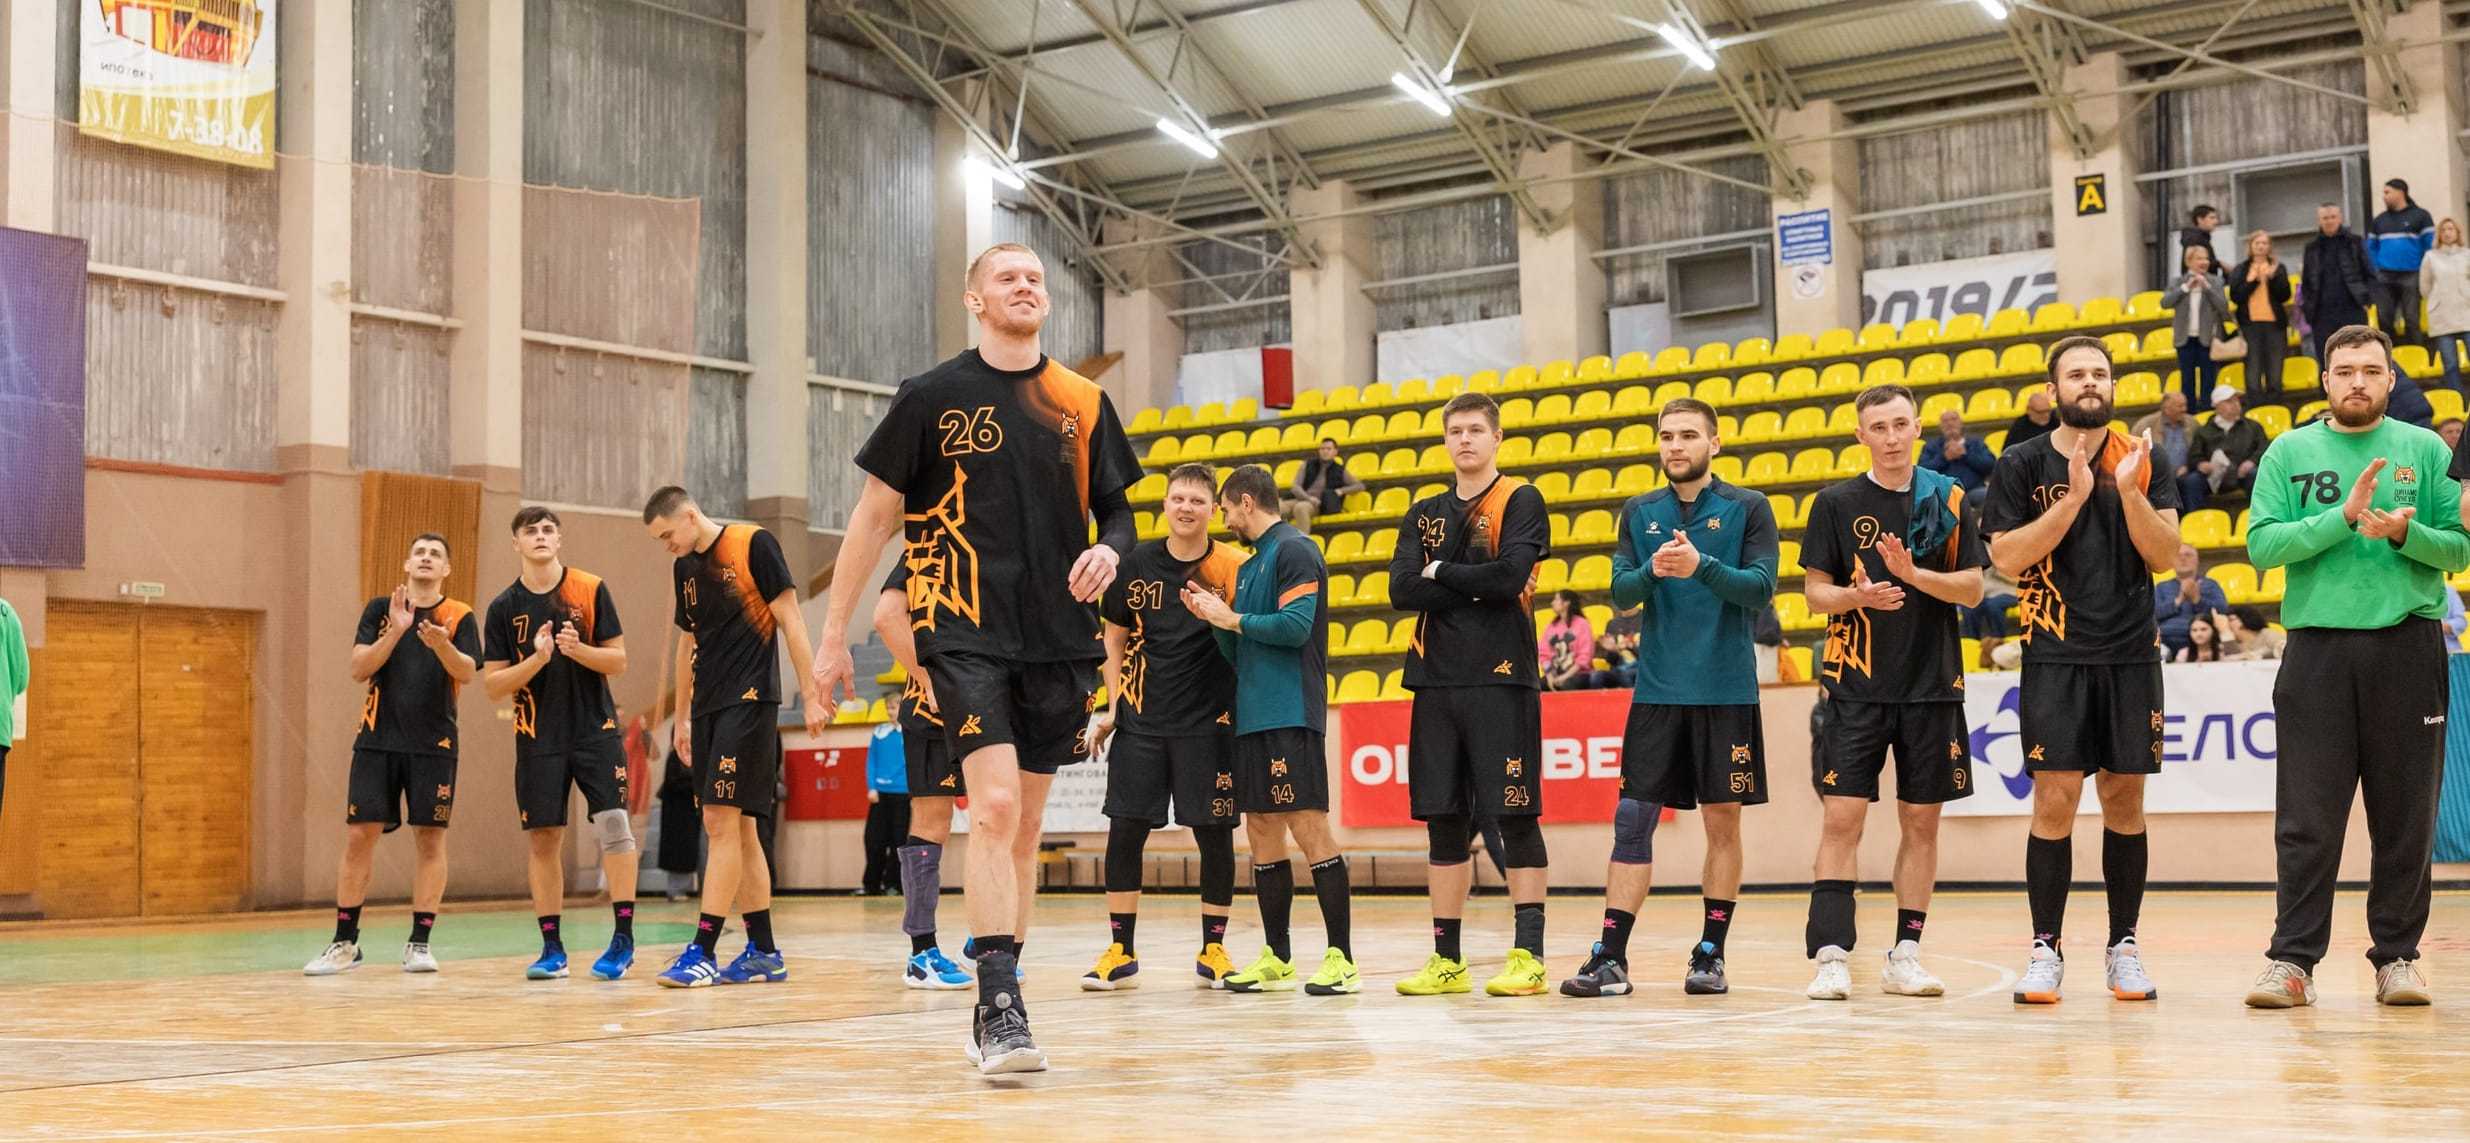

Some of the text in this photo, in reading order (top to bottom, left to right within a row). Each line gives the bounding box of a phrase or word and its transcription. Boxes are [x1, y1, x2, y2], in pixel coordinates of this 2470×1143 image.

[938, 406, 1003, 457] 26
[2290, 470, 2342, 509] 78
[1853, 515, 1880, 550] 9
[1126, 579, 1164, 610] 31
[512, 614, 530, 644] 7
[714, 780, 736, 799] 11
[1730, 772, 1754, 793] 51
[1953, 768, 1967, 790] 9
[1271, 783, 1295, 804] 14
[1504, 785, 1530, 806] 24
[1212, 798, 1234, 817] 31
